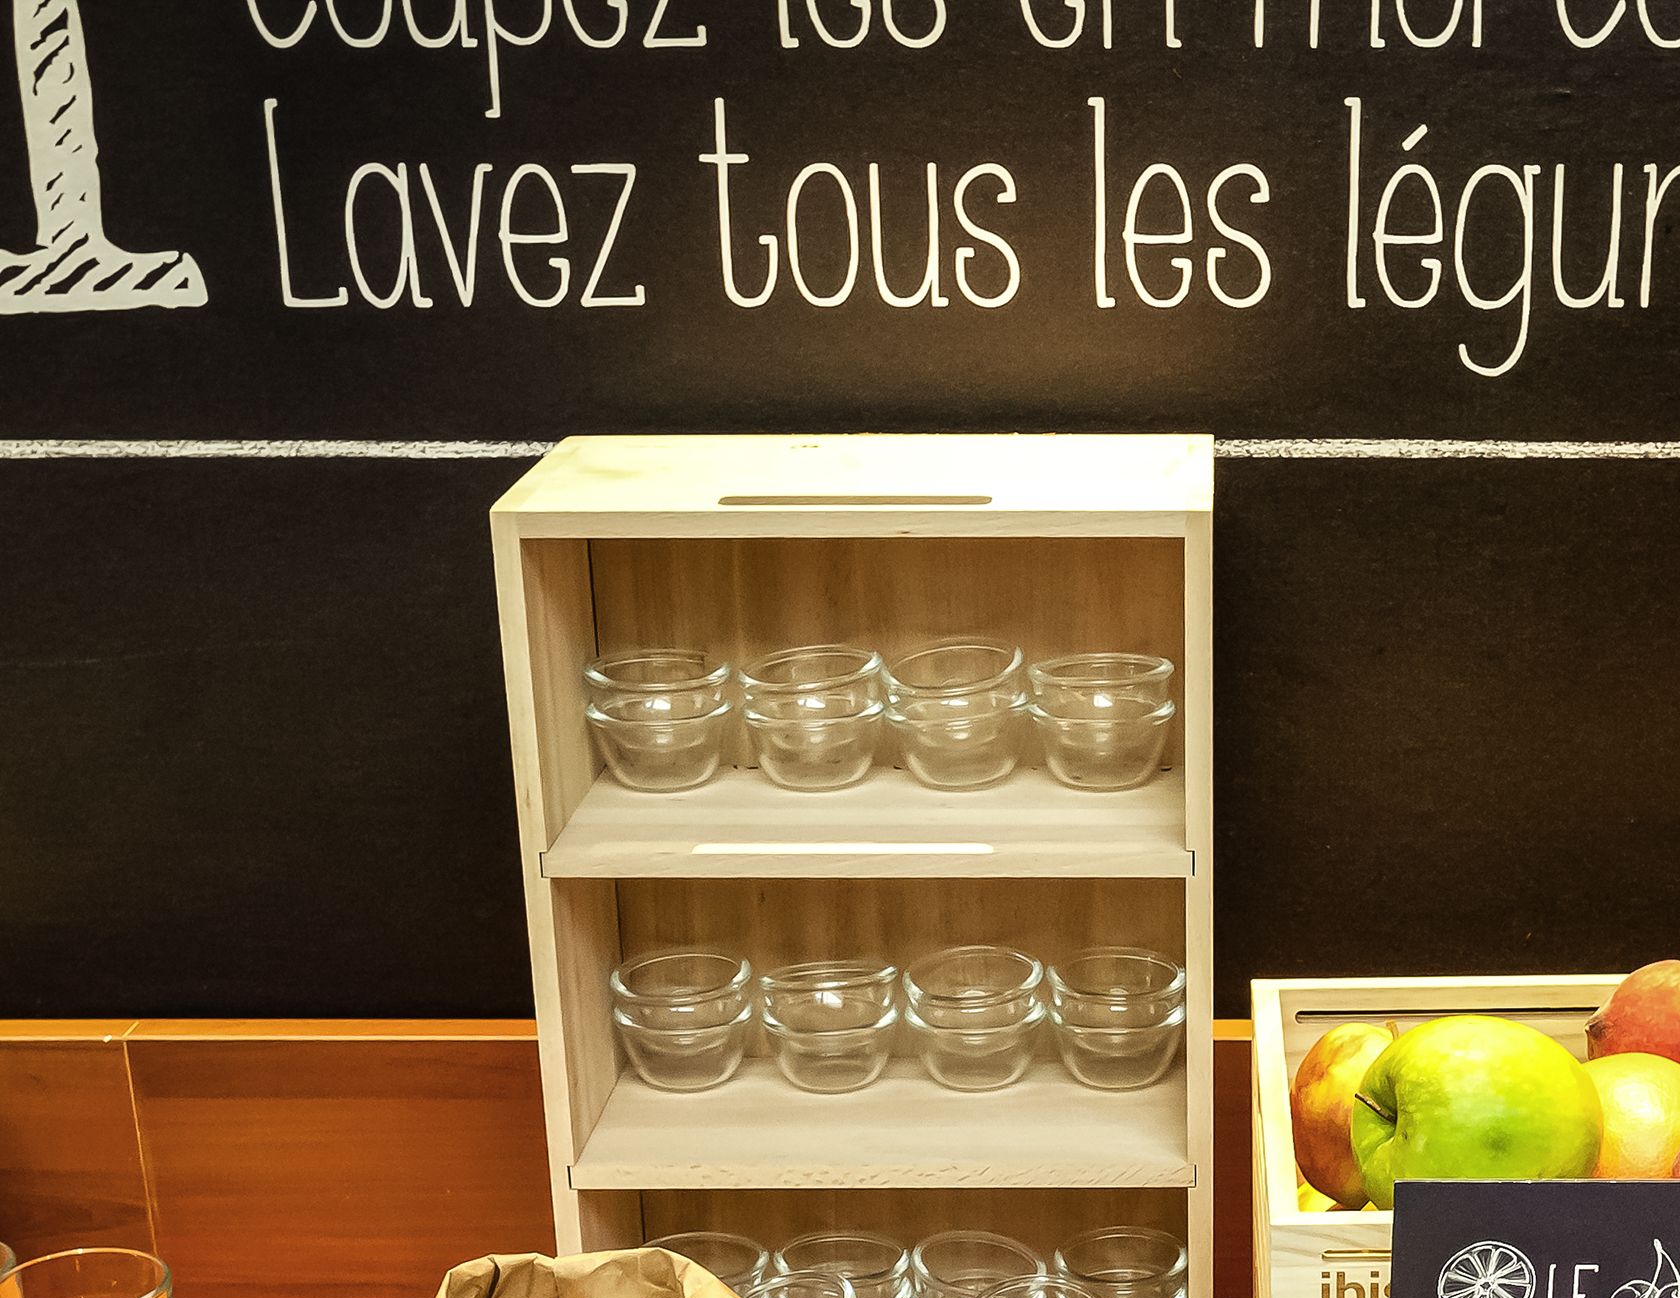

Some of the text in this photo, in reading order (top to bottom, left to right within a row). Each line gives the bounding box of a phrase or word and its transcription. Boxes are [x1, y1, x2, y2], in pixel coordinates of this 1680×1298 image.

[263, 98, 645, 307] Lavez
[699, 98, 1020, 307] tous
[1088, 97, 1272, 309] les
